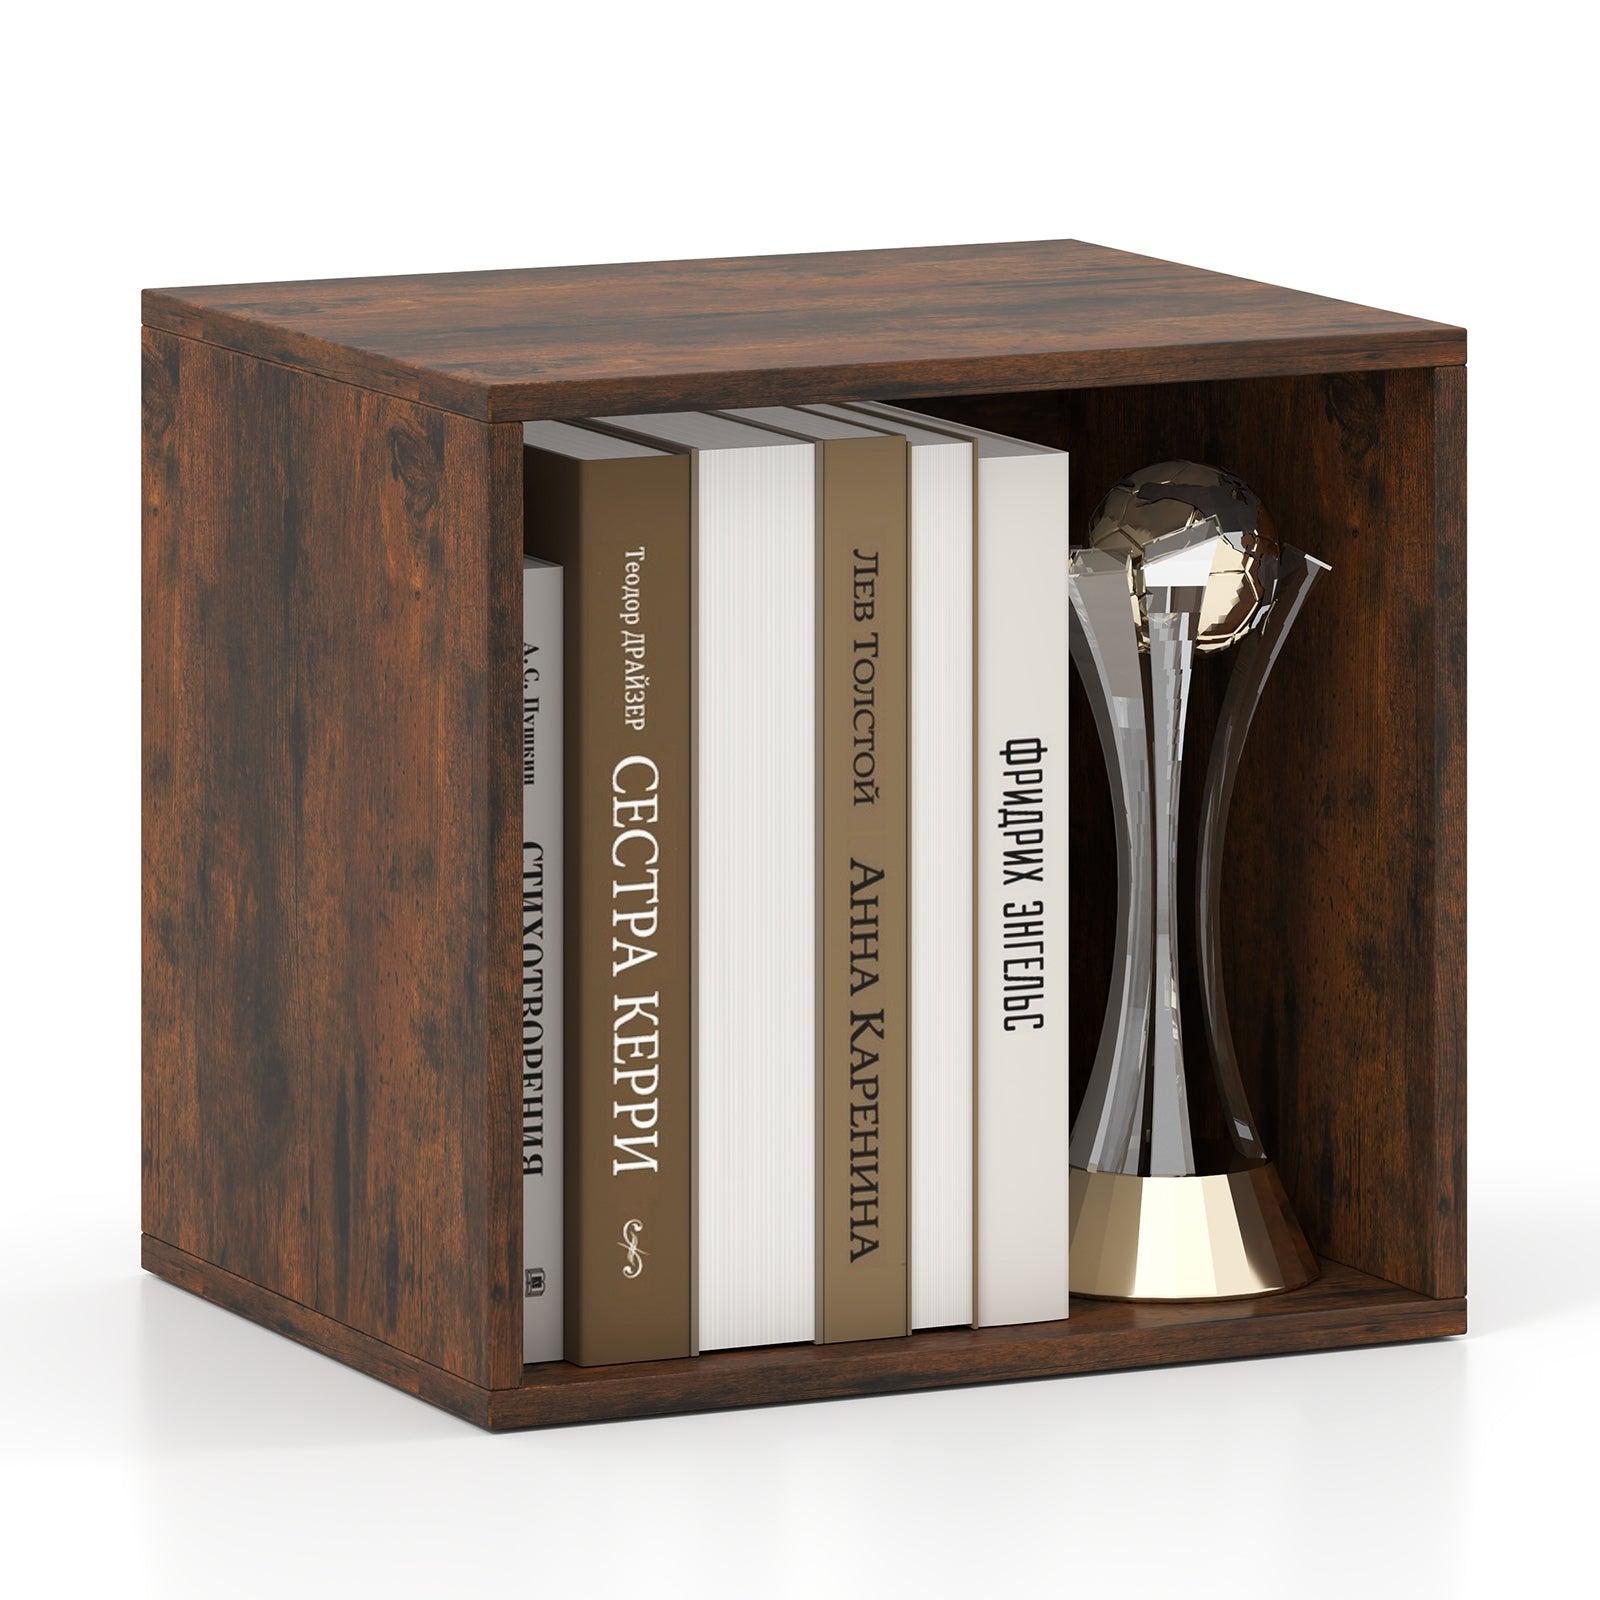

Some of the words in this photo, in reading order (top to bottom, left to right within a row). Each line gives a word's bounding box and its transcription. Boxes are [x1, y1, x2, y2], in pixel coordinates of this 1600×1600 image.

[619, 546, 646, 625] Теодор
[852, 548, 879, 622] ЛЕВ
[524, 697, 540, 786] Пушкин
[620, 630, 651, 731] ДРАЙЗЕР
[611, 755, 660, 978] СЕСТРА
[997, 737, 1049, 886] ФРИДРИХ
[524, 841, 544, 1176] СТИХОТВОРЕНИЯ
[1002, 900, 1045, 1032] ЭНГЕЛЬС
[612, 990, 660, 1177] КЕРРИ
